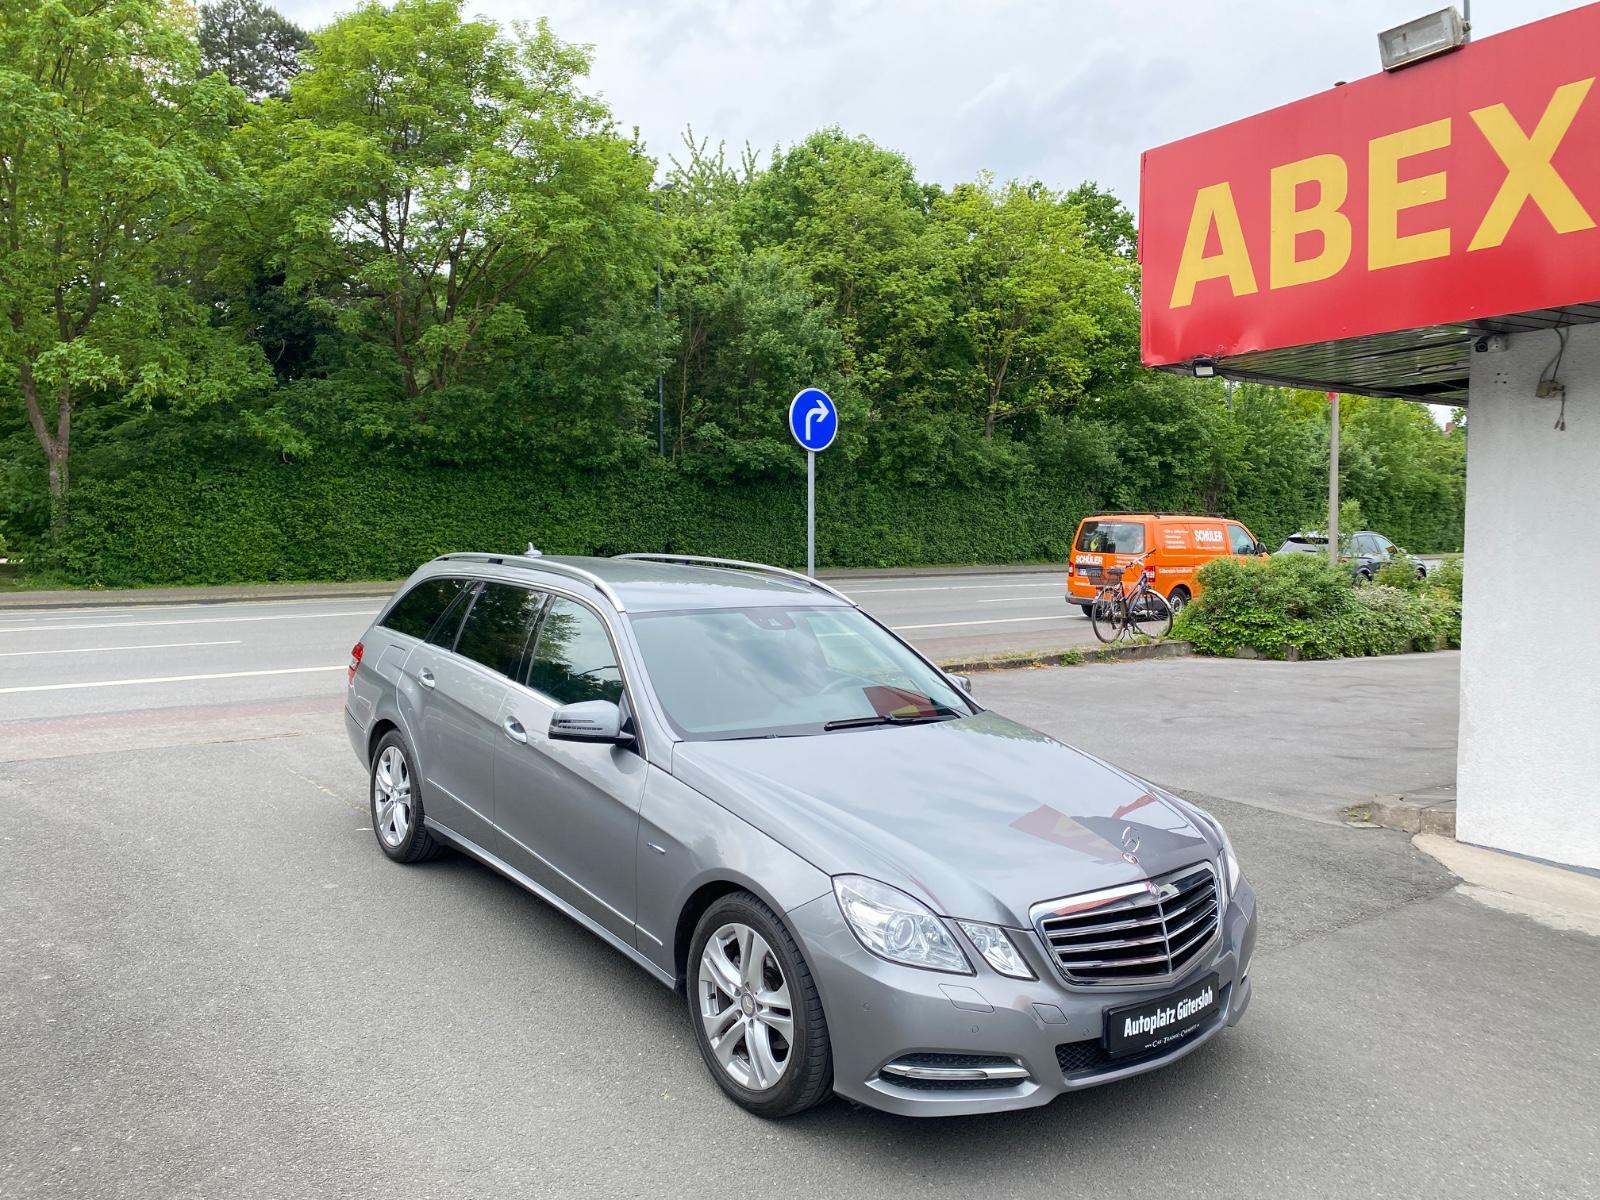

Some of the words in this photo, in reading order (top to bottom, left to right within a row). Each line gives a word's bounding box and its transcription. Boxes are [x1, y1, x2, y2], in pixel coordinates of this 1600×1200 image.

[1168, 77, 1598, 309] ABEX
[1194, 528, 1224, 542] SCHÜLER
[1075, 553, 1104, 565] SCHÜLER
[1123, 1007, 1176, 1038] Autoplatz
[1176, 985, 1213, 1021] Gütersloh
